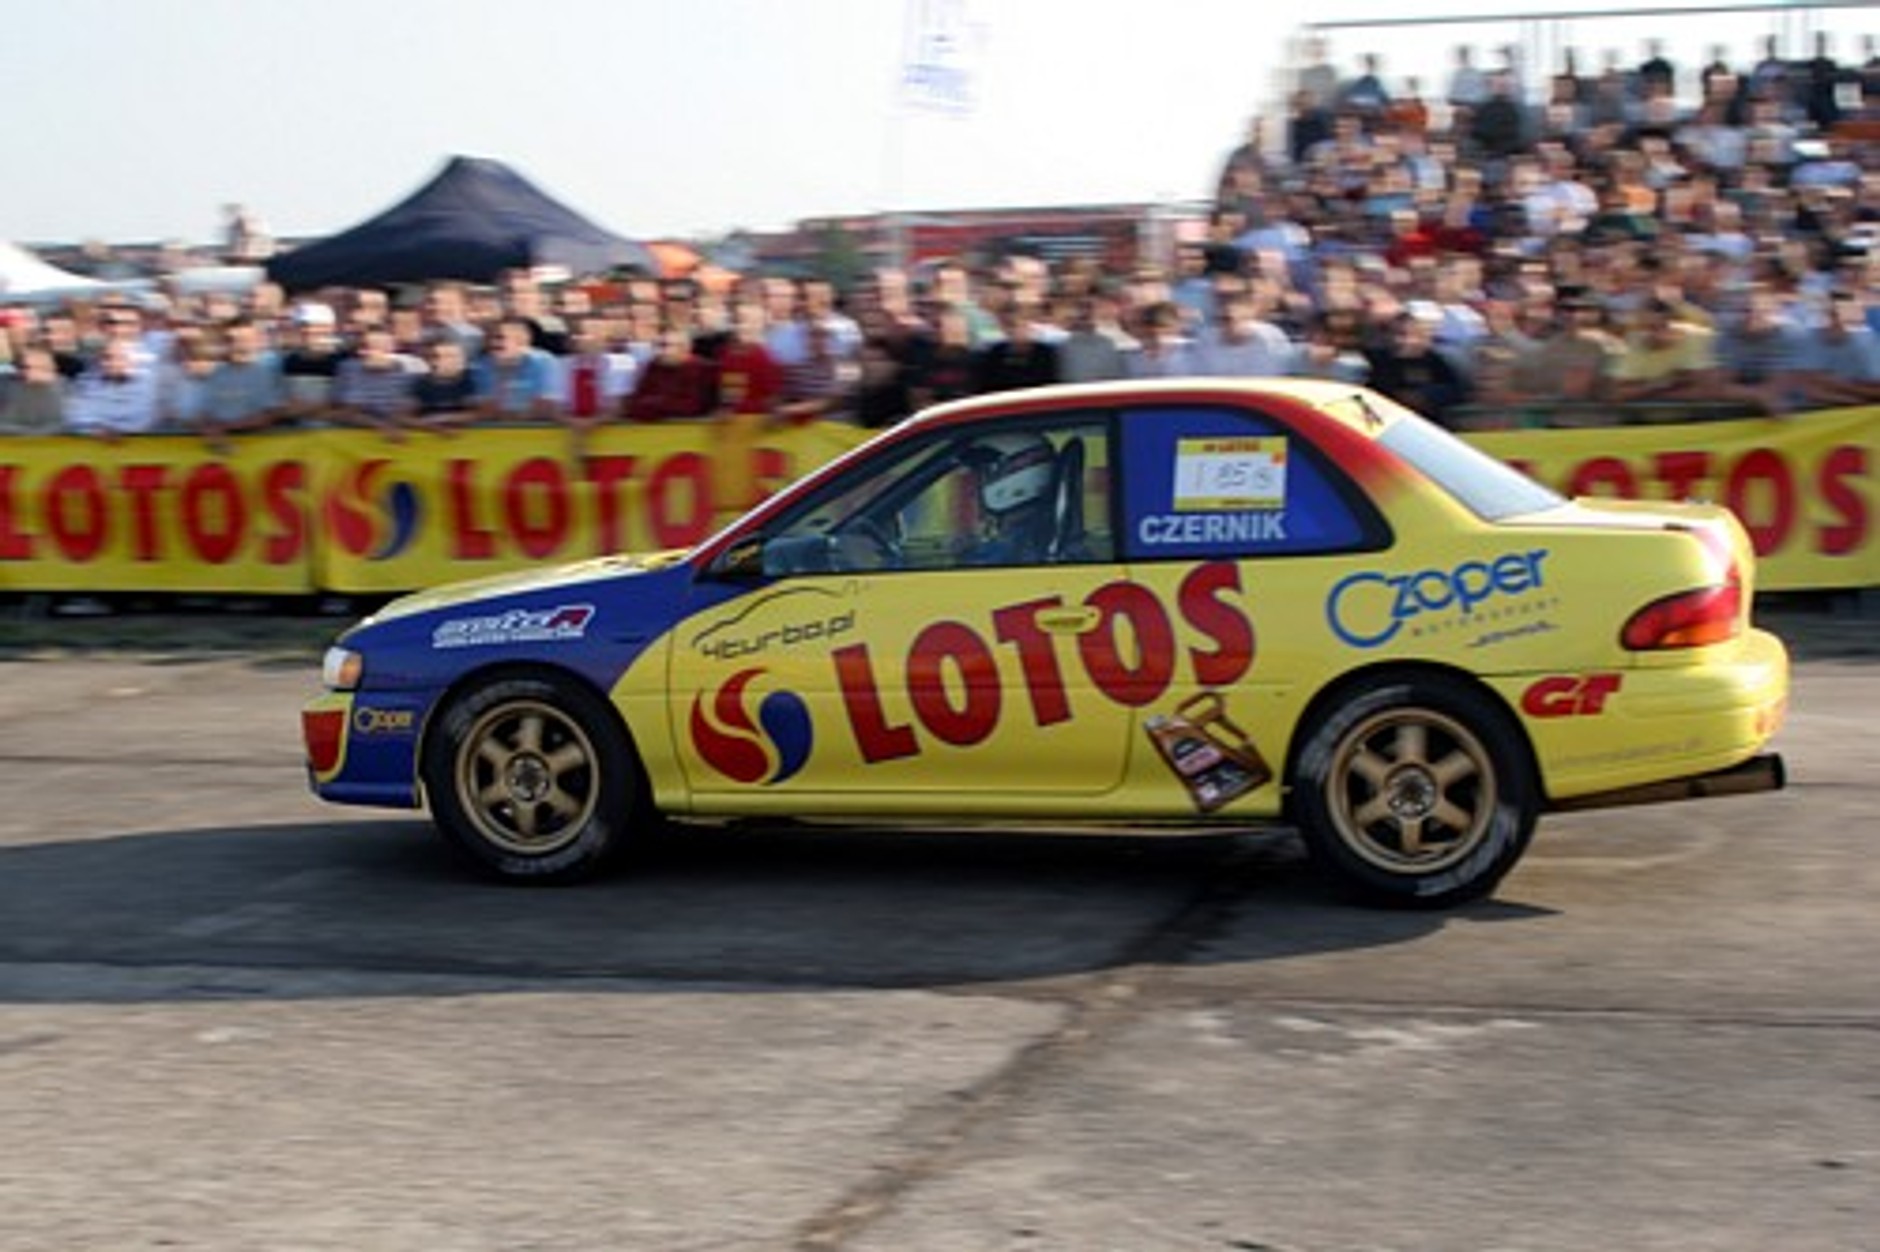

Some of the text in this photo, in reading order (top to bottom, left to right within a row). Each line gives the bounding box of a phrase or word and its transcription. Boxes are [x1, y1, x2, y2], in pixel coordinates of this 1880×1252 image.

[0, 461, 308, 564] LOTOS
[1138, 512, 1287, 544] CZERNIK
[1325, 548, 1549, 649] Czoper
[831, 560, 1256, 764] LOTOS
[1520, 673, 1624, 718] GT
